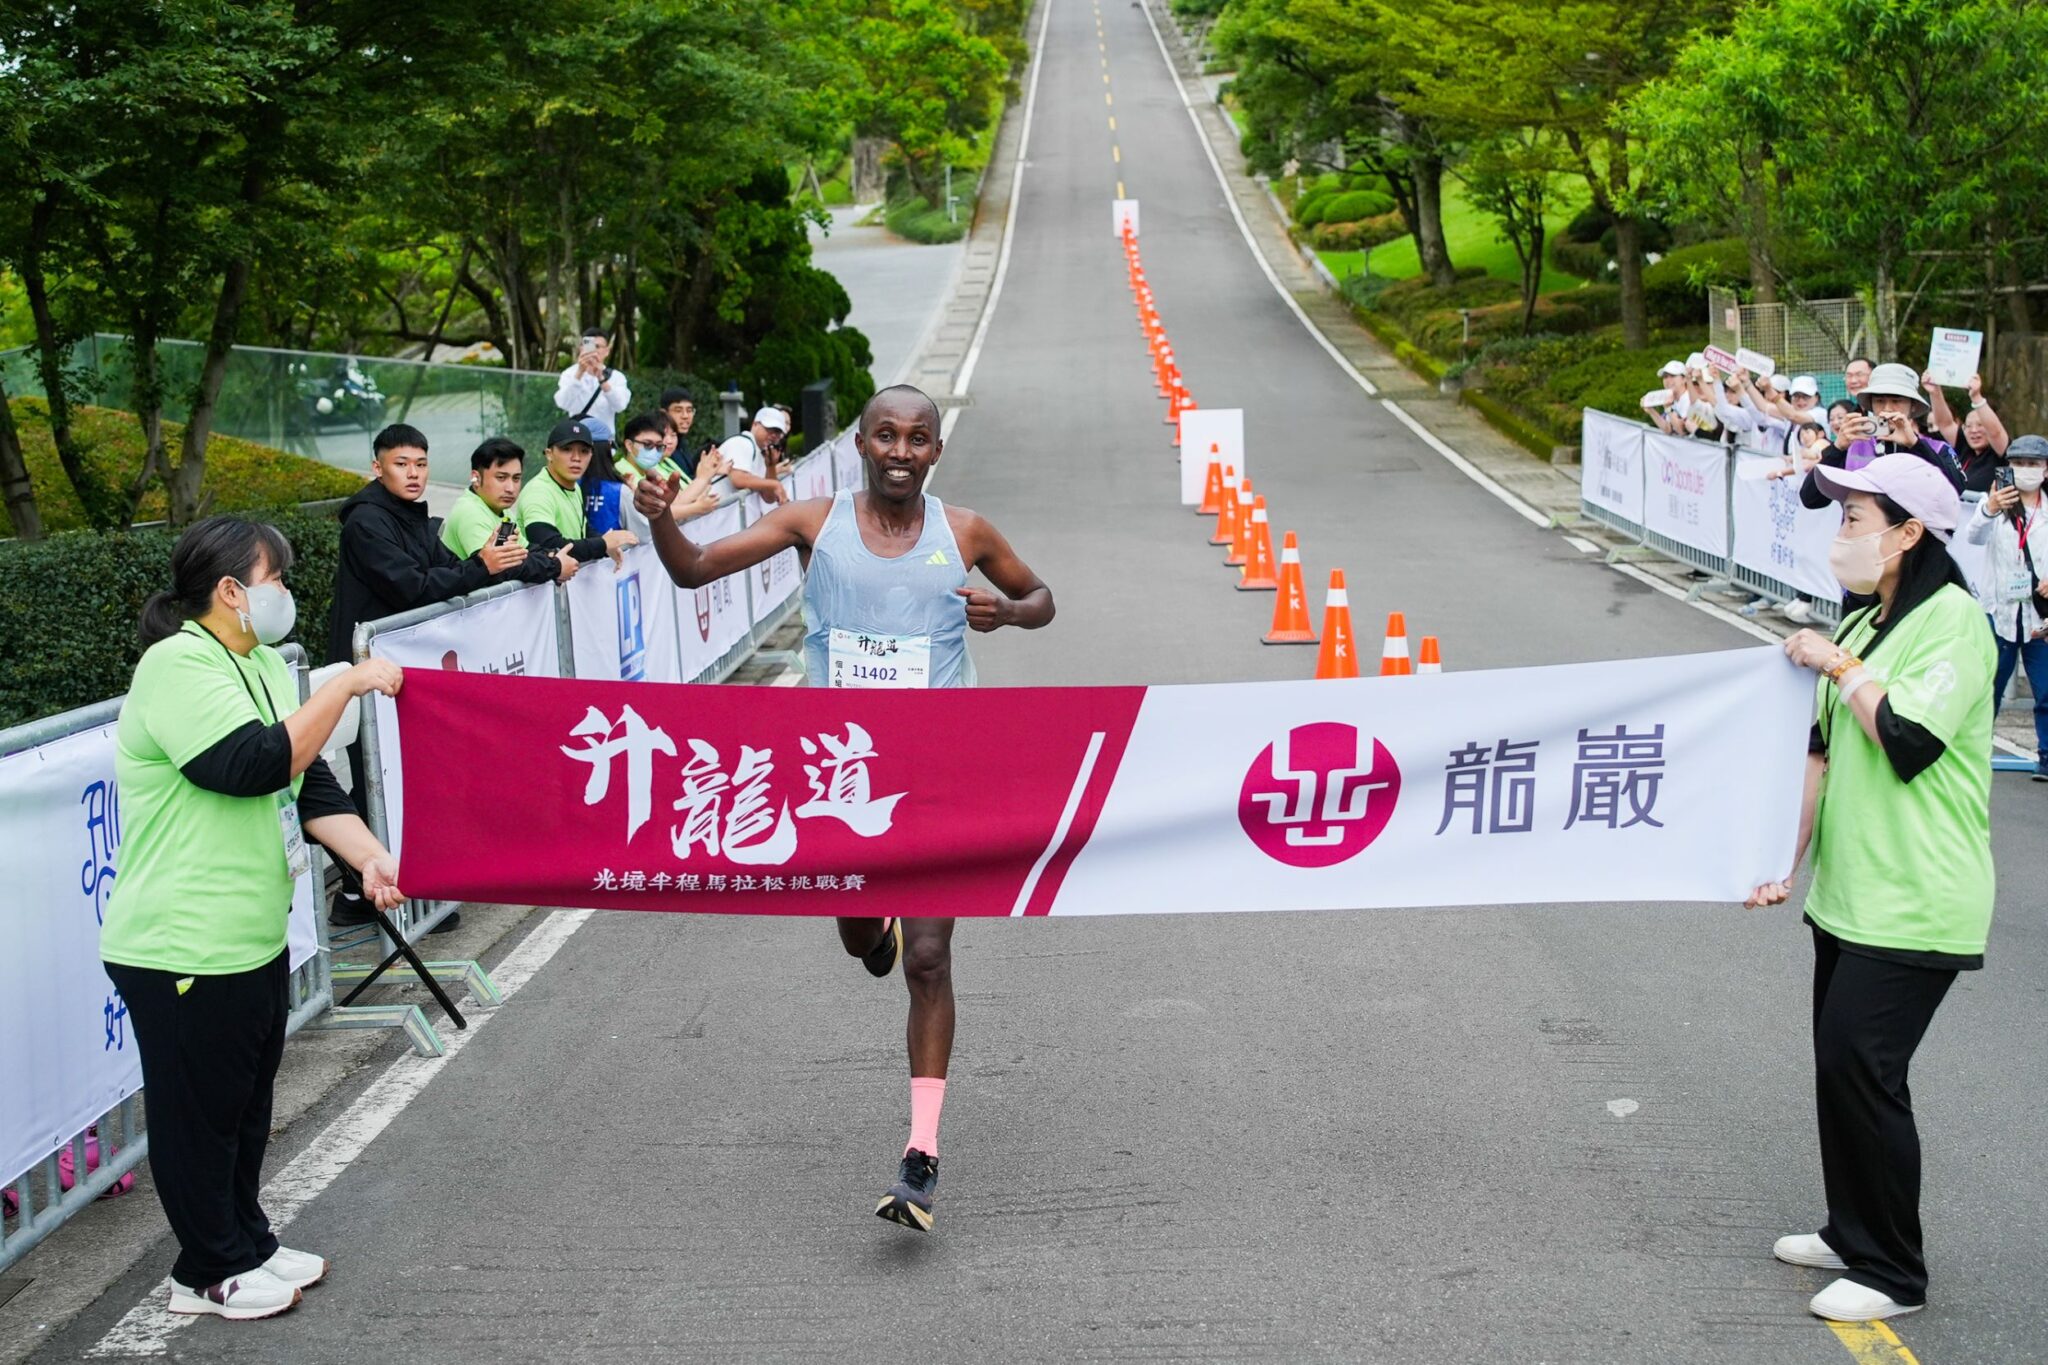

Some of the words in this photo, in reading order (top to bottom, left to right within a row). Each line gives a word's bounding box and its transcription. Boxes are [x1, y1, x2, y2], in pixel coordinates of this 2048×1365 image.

[1289, 583, 1301, 610] LK
[857, 635, 899, 657] 升龍道
[1335, 625, 1347, 658] LK
[852, 664, 898, 681] 11402
[559, 703, 910, 866] 升龍道
[1434, 724, 1666, 836] 龍巖
[591, 867, 867, 893] 光境半程馬拉松挑戰賽
